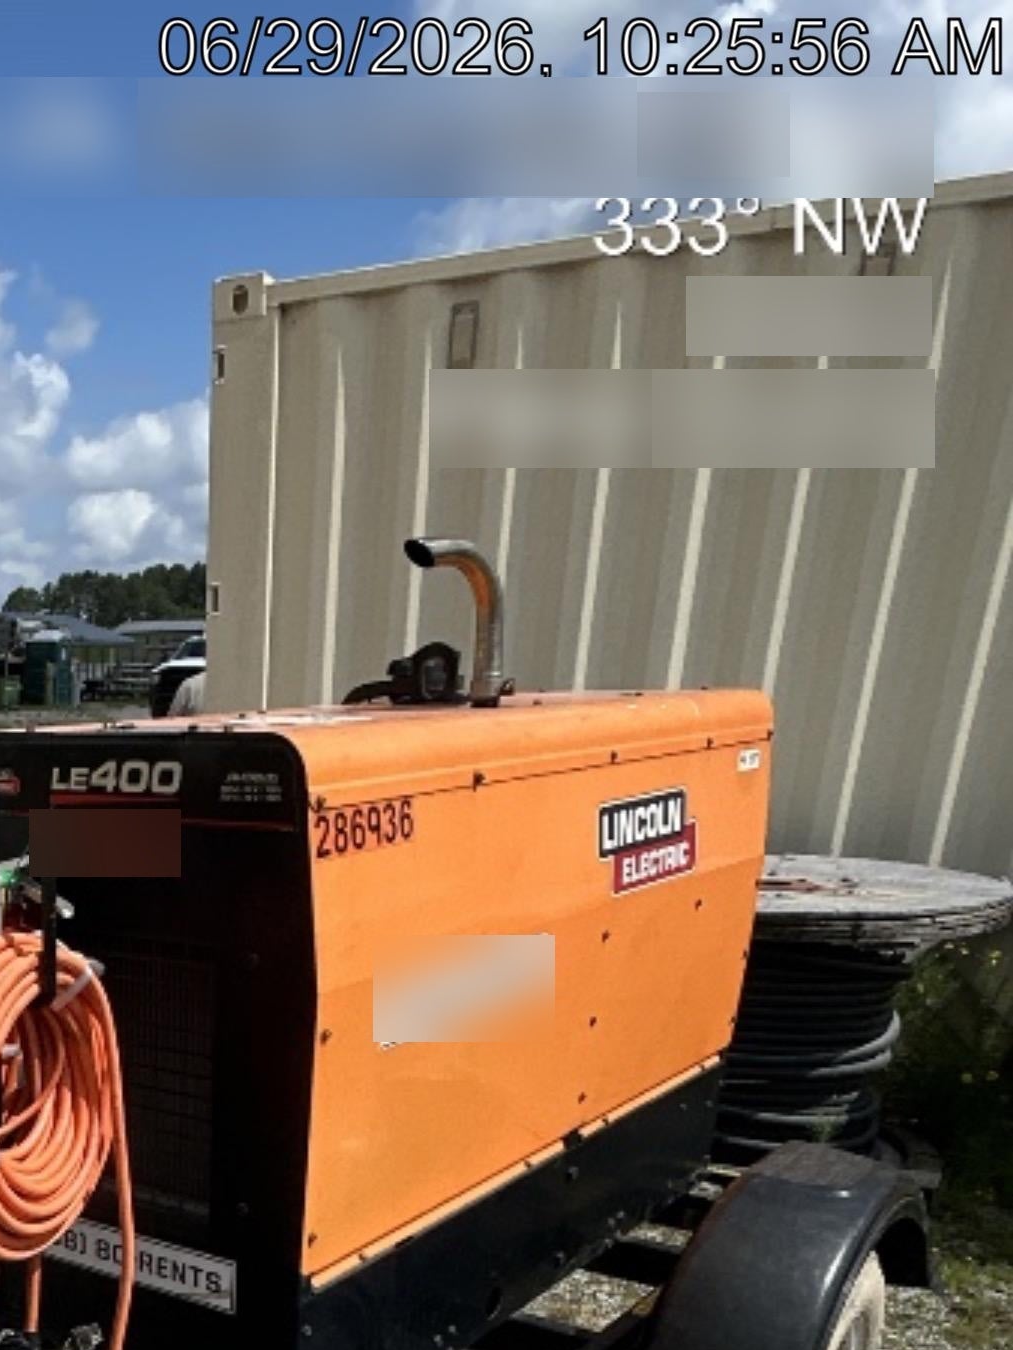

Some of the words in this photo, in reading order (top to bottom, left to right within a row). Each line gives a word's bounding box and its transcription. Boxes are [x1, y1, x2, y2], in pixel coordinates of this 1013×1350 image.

[50, 760, 184, 795] LE400
[313, 799, 415, 859] 286936
[601, 797, 683, 850] LINCOLN
[621, 841, 691, 886] ELECTRIC
